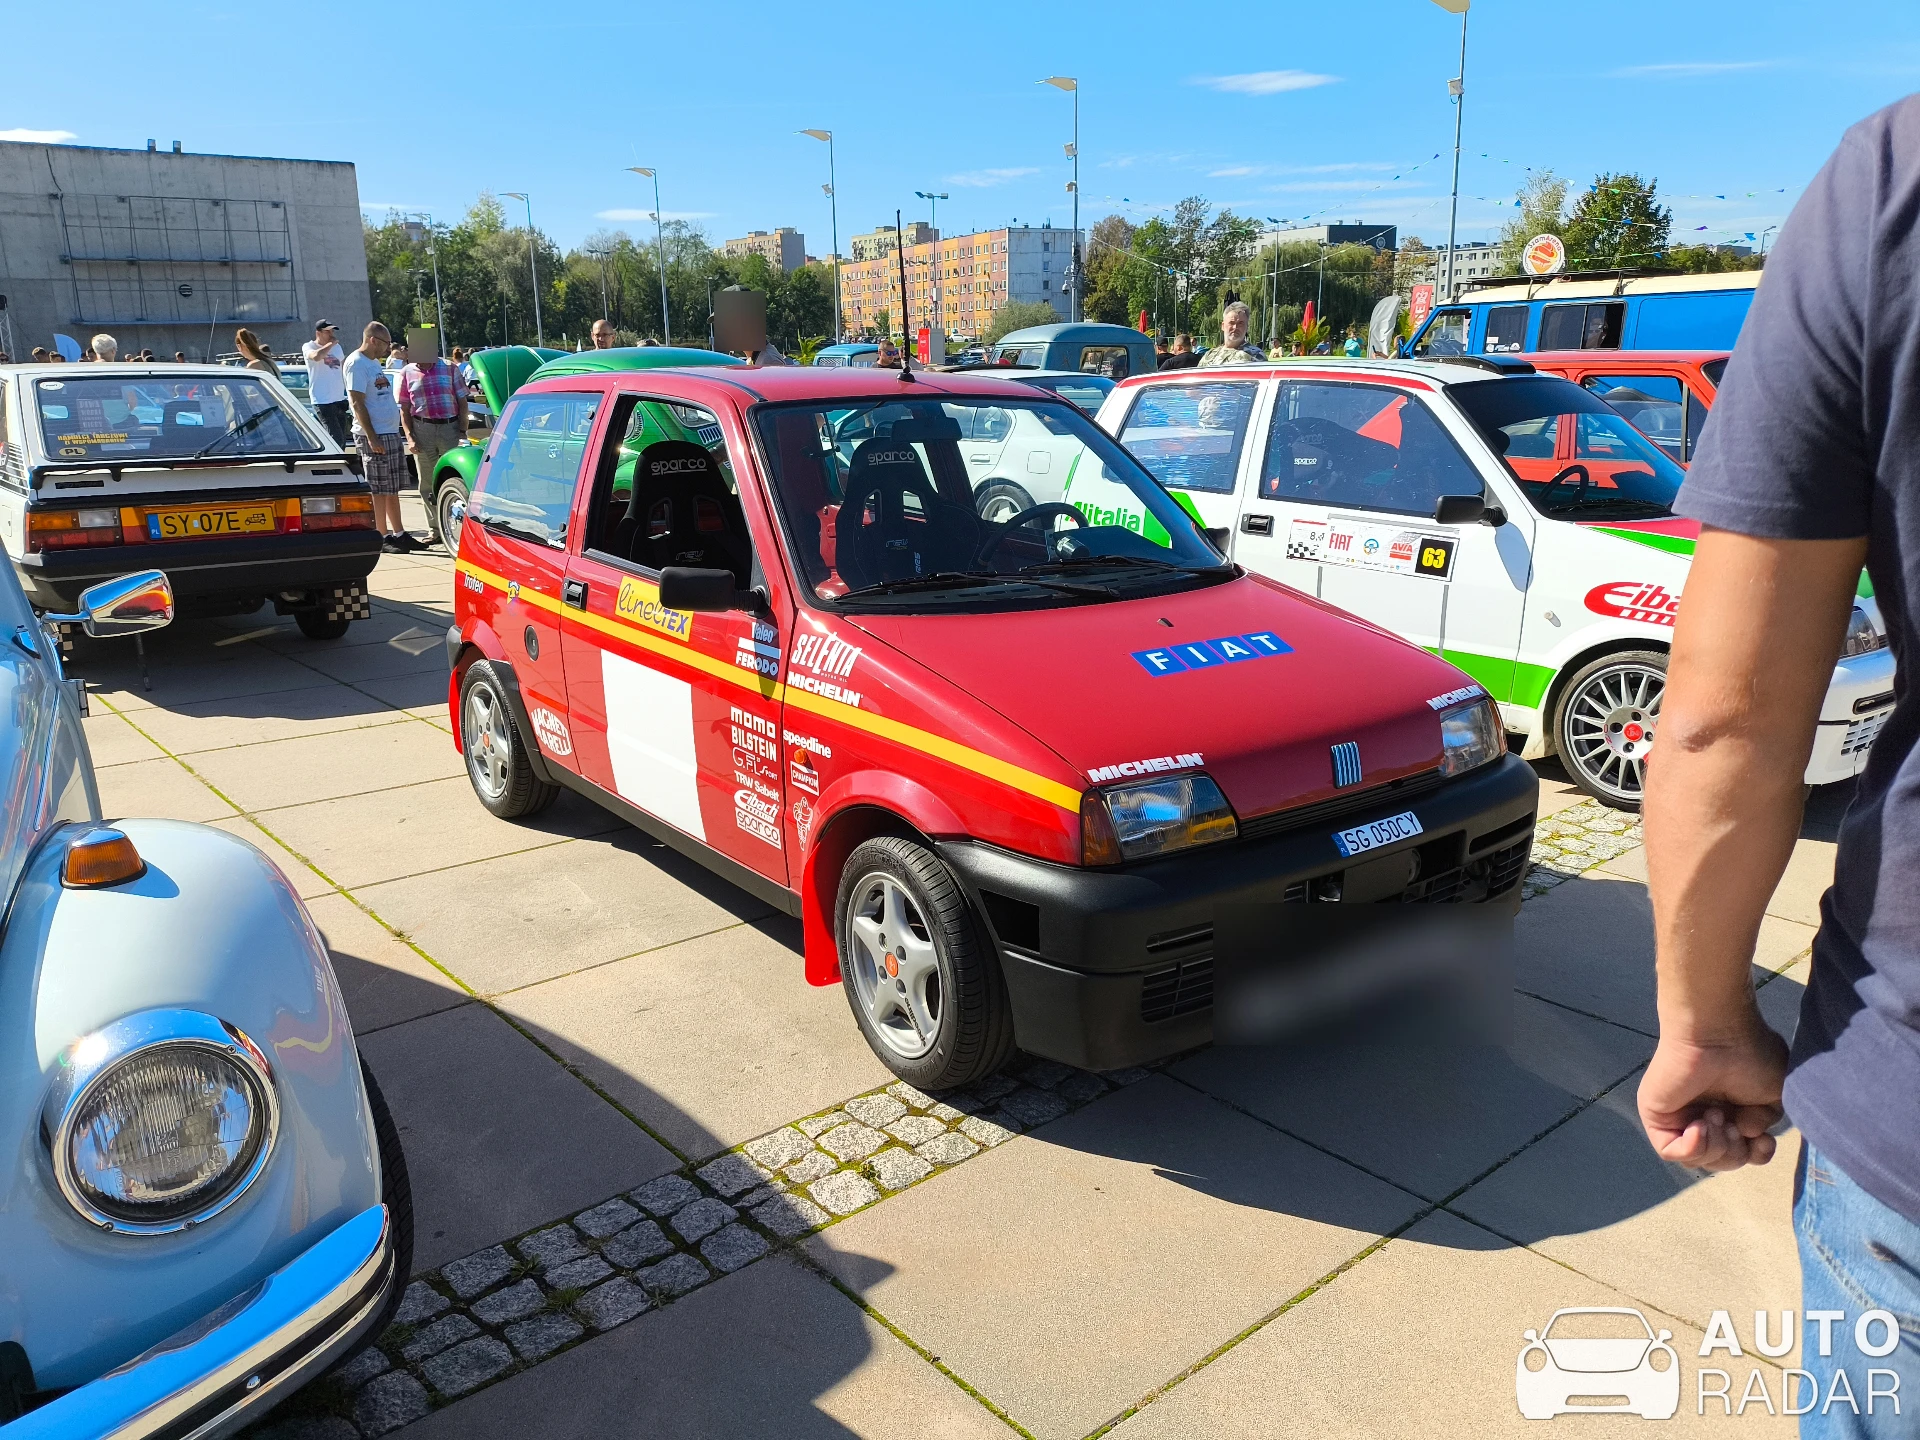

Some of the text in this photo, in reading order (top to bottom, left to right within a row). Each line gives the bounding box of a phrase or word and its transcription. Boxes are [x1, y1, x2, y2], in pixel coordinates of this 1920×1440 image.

[651, 459, 707, 475] sparco
[868, 451, 915, 466] sparco
[163, 511, 241, 535] SY 07E
[1328, 533, 1354, 551] FIAT
[1391, 542, 1413, 553] AVIA
[1421, 547, 1446, 569] 63
[463, 571, 484, 594] Trofeo
[752, 621, 774, 644] Valeo
[735, 650, 779, 676] FERODO
[791, 632, 863, 678] SELENIA
[1146, 634, 1279, 671] FIAT
[787, 671, 864, 708] MICHELIN
[1425, 684, 1484, 711] MICHELIN
[731, 725, 777, 762] BILSTEIN
[783, 729, 832, 759] speedline
[791, 768, 819, 788] CHAMPION
[1087, 752, 1205, 783] MICHELIN
[734, 769, 780, 803] TRW Sabelt
[734, 789, 780, 825] Eibach
[737, 811, 780, 844] sparco
[1344, 813, 1418, 852] SG 050CY
